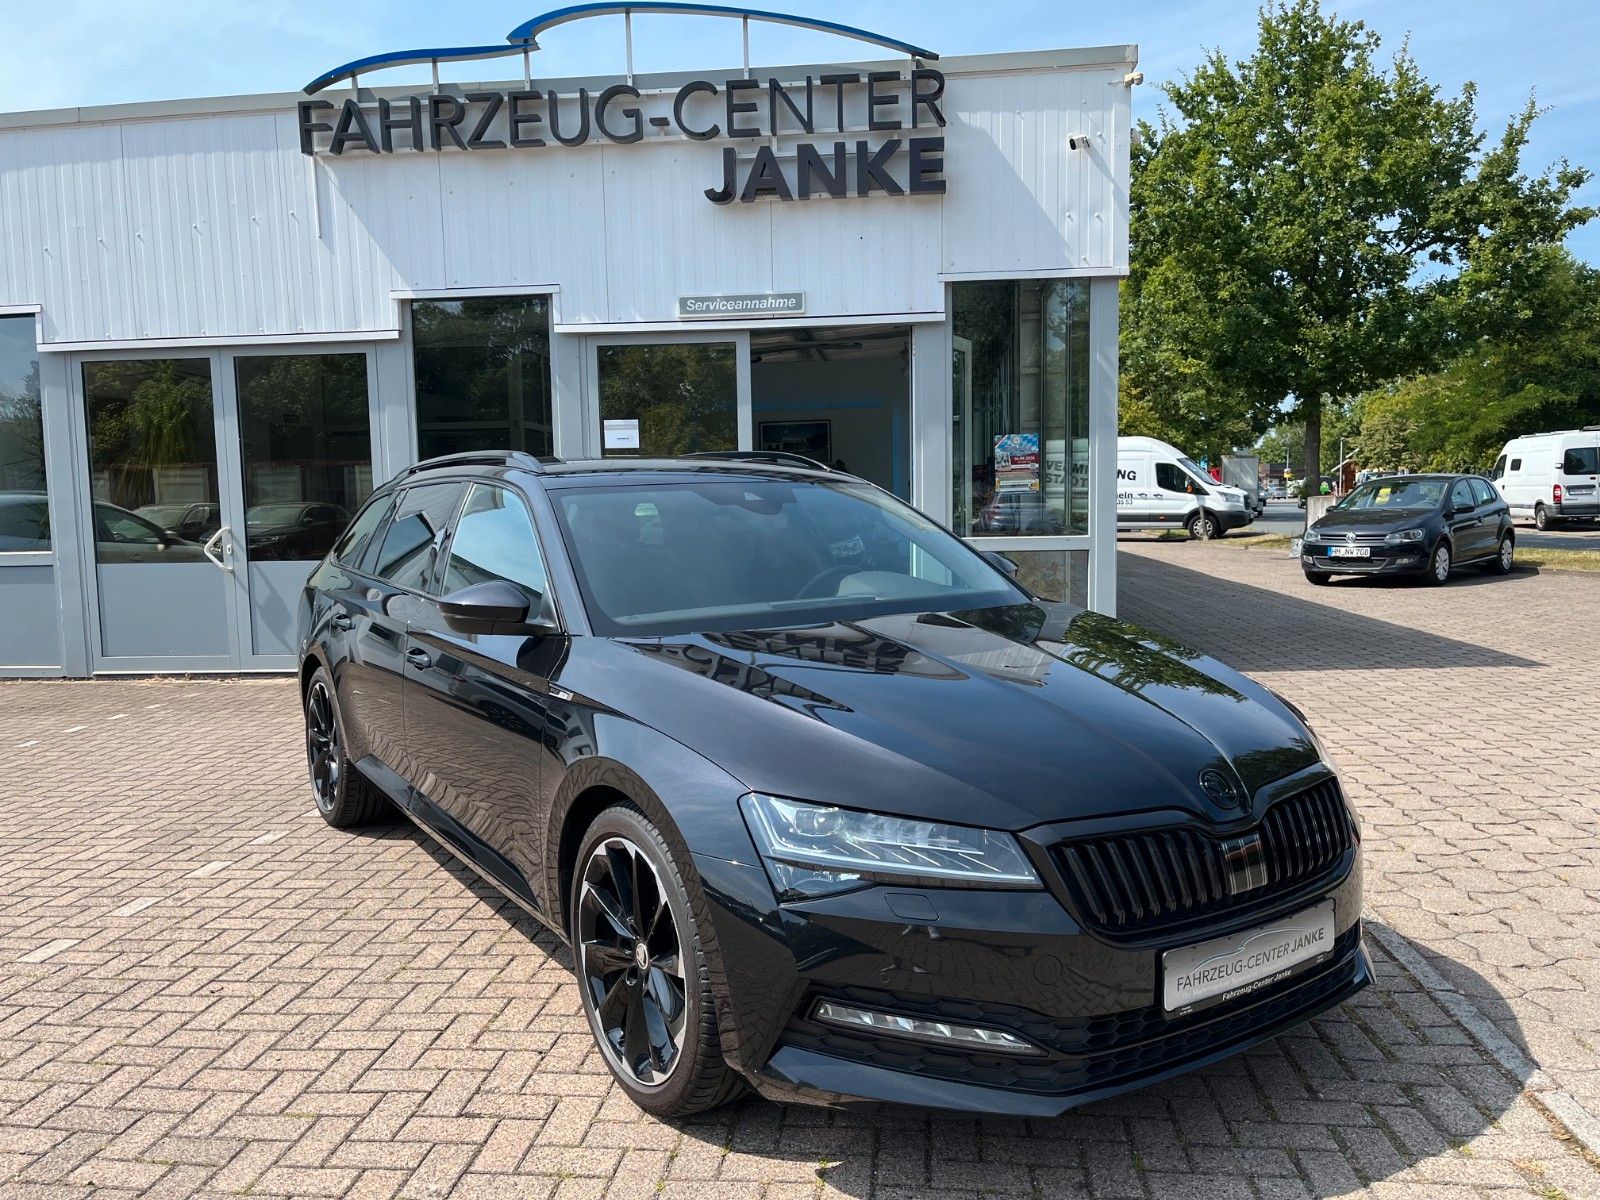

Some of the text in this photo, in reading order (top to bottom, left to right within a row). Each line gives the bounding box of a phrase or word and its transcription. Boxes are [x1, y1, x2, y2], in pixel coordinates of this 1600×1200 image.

[298, 69, 946, 156] FAHRZEUG-CENTER
[704, 136, 946, 205] JANKE
[686, 297, 796, 311] Serviceannahme
[1177, 943, 1289, 991] FAHRZEUG-CENTER
[1292, 927, 1325, 952] JANKE
